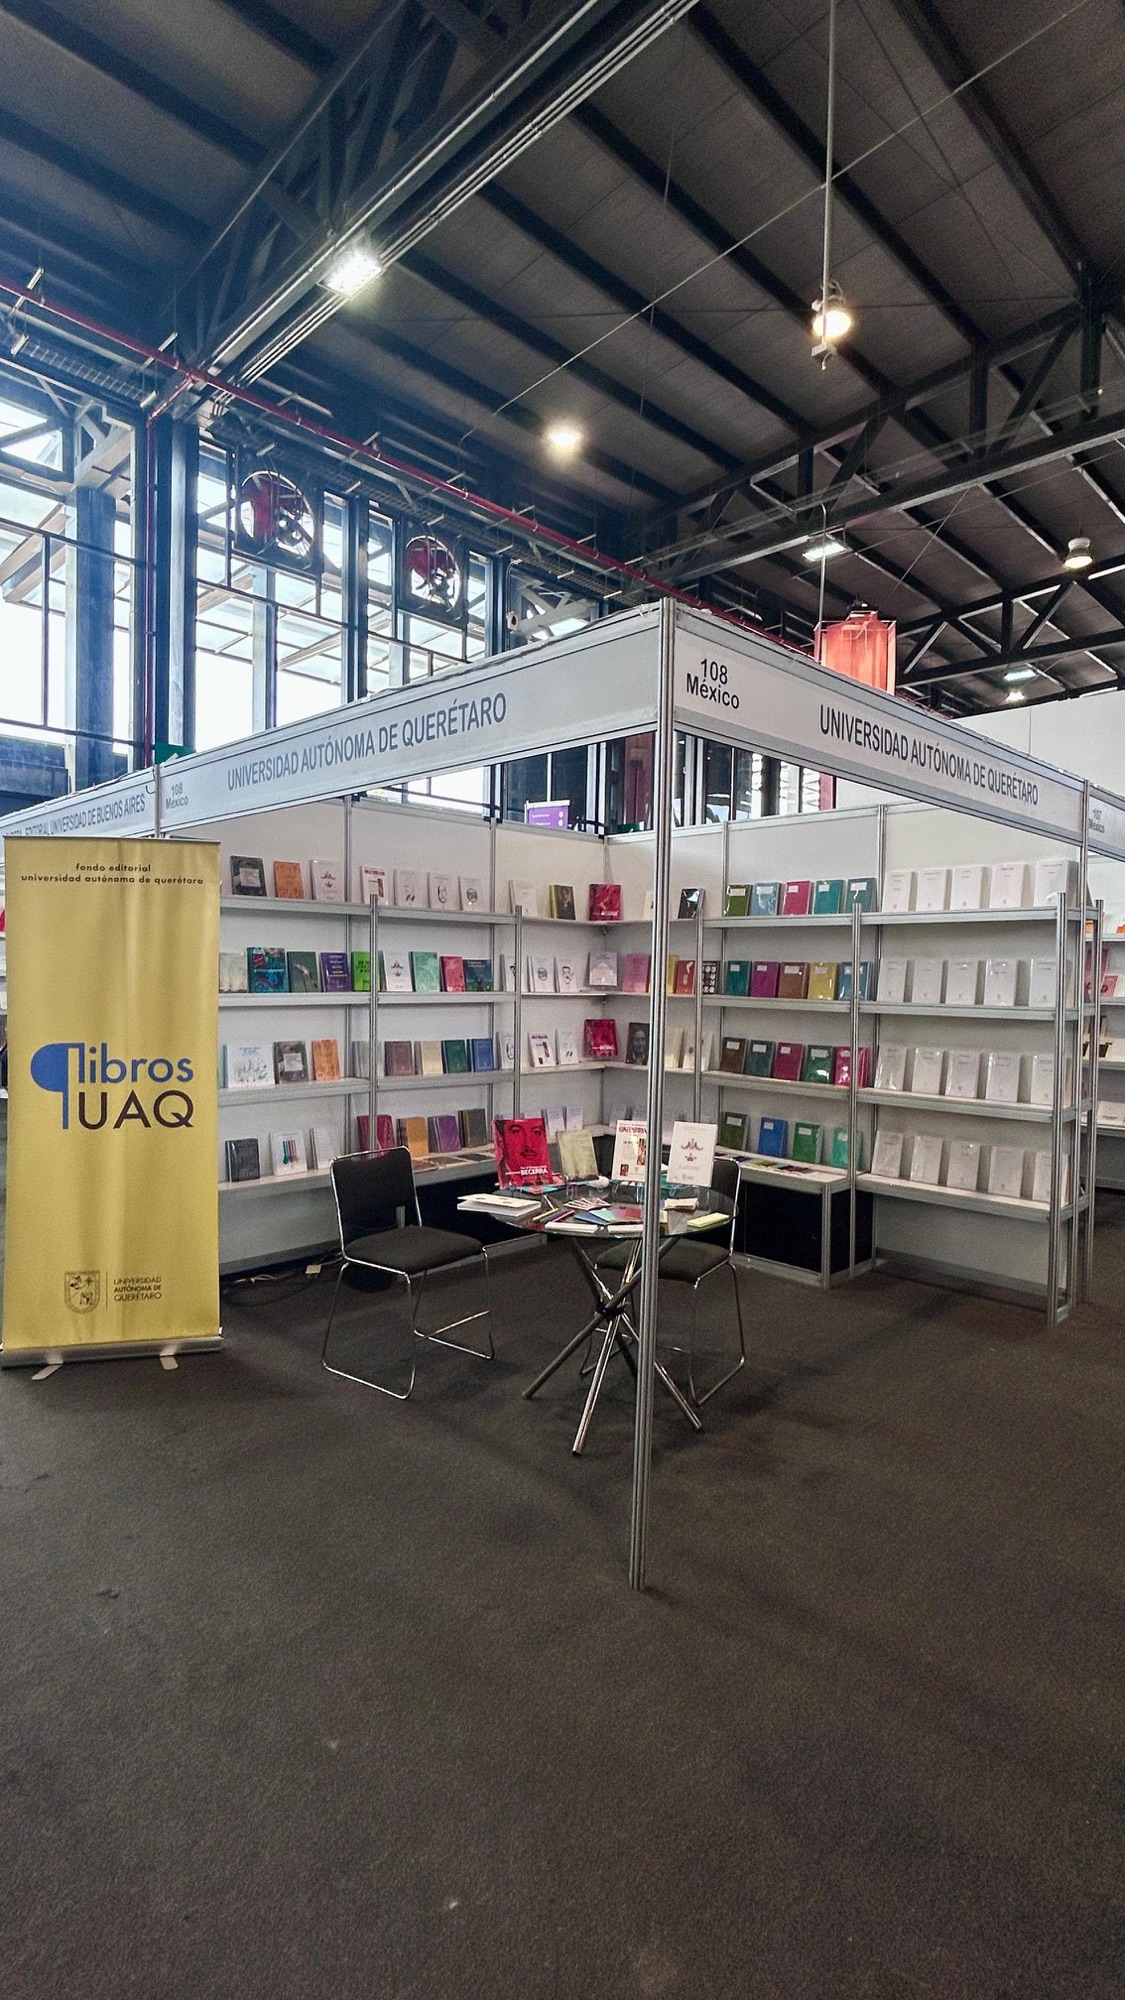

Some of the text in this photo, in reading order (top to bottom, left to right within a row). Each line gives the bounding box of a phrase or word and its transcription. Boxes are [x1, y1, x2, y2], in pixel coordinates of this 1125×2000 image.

[699, 658, 729, 685] 108
[685, 673, 740, 710] México
[226, 692, 507, 791] UNIVERSIDAD AUTÓNOMA DE QUERÉTARO
[820, 703, 1039, 806] UNIVERSIDAD AUTÓNOMA DE QUERÉTARO
[171, 784, 184, 797] 108
[165, 796, 189, 809] México
[51, 811, 87, 836] UNIVERSIDAD
[87, 809, 96, 826] DE
[97, 800, 123, 823] BUENOS
[124, 793, 146, 815] AIRES
[75, 863, 151, 872] fondo editorial
[21, 873, 204, 886] universidad autónoma de querétaro
[78, 1042, 194, 1084] libros
[78, 1089, 194, 1130] UAQ
[113, 1276, 162, 1286] UNIVERSIDAD
[113, 1284, 152, 1293] AUTÓNOMA
[113, 1291, 162, 1302] QUERÉTARO
